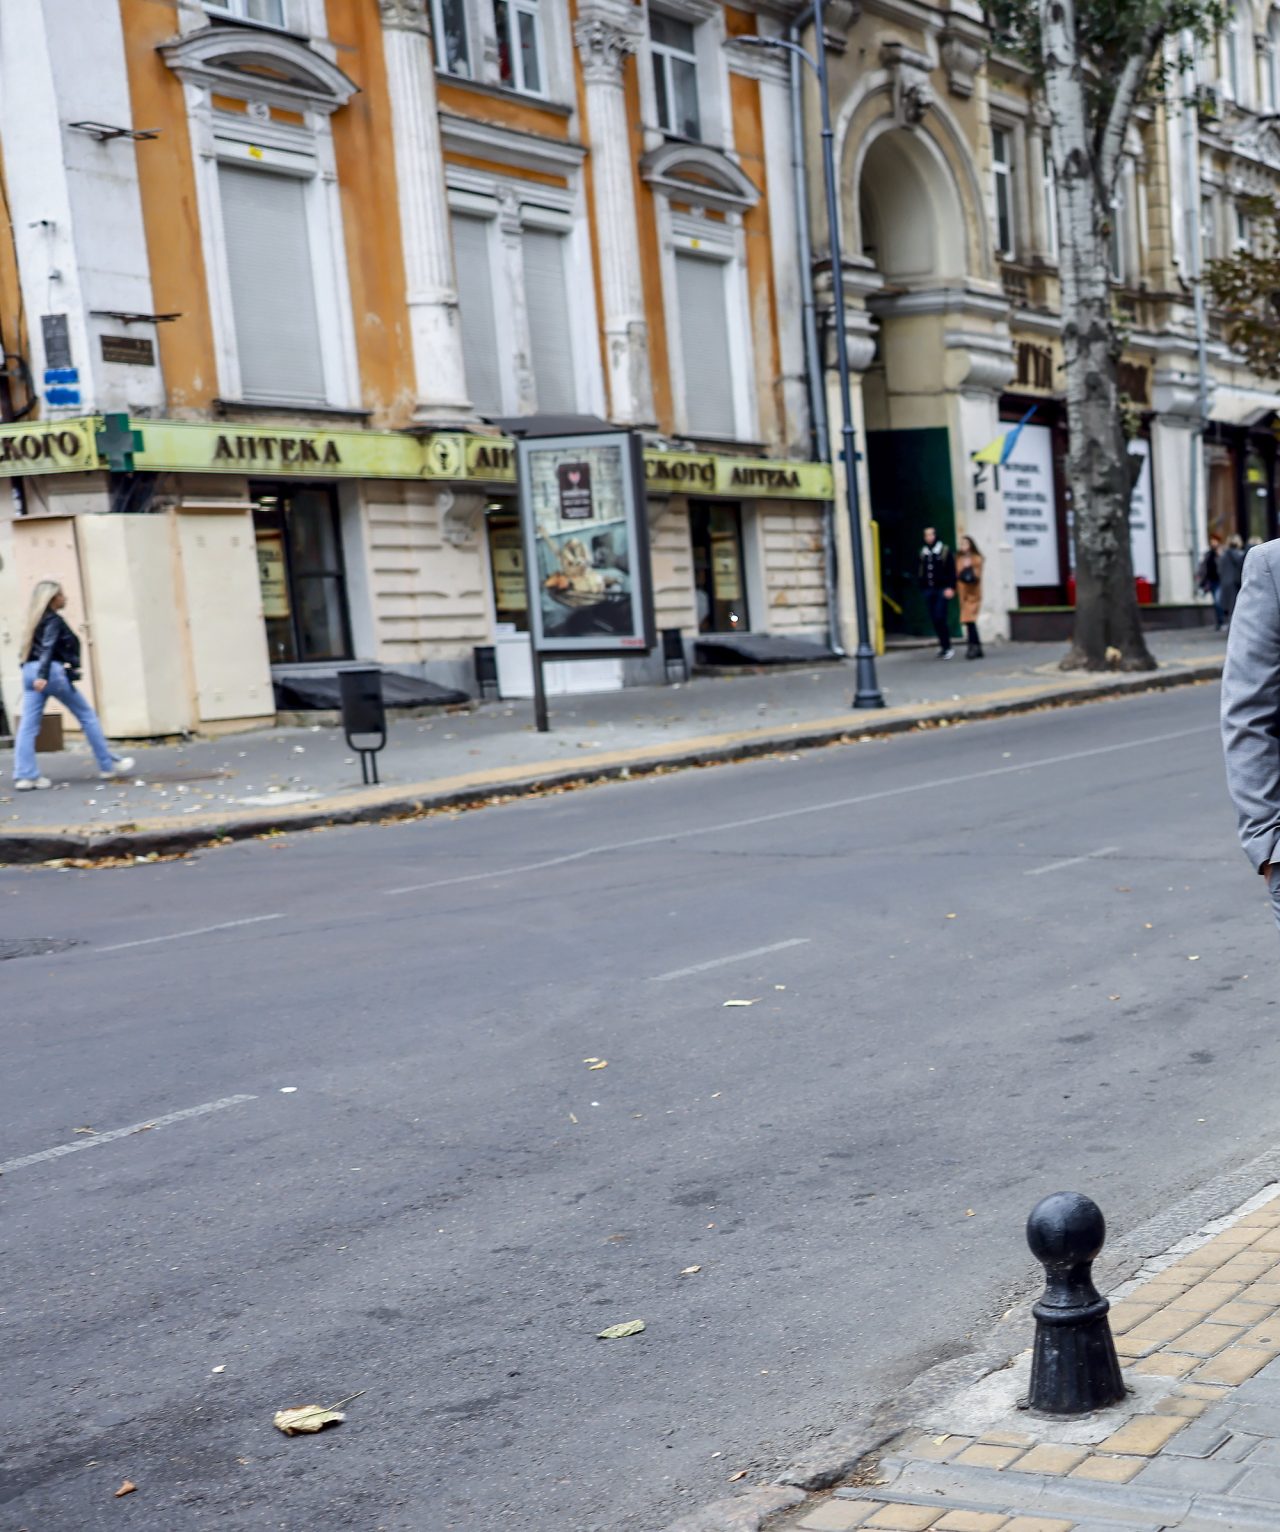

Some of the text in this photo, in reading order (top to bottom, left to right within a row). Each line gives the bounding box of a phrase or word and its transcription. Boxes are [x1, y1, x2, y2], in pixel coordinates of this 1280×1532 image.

[0, 431, 80, 462] КОГО
[213, 434, 341, 463] АПТЕКА
[475, 446, 514, 469] АП
[731, 466, 801, 487] АПТЕКА
